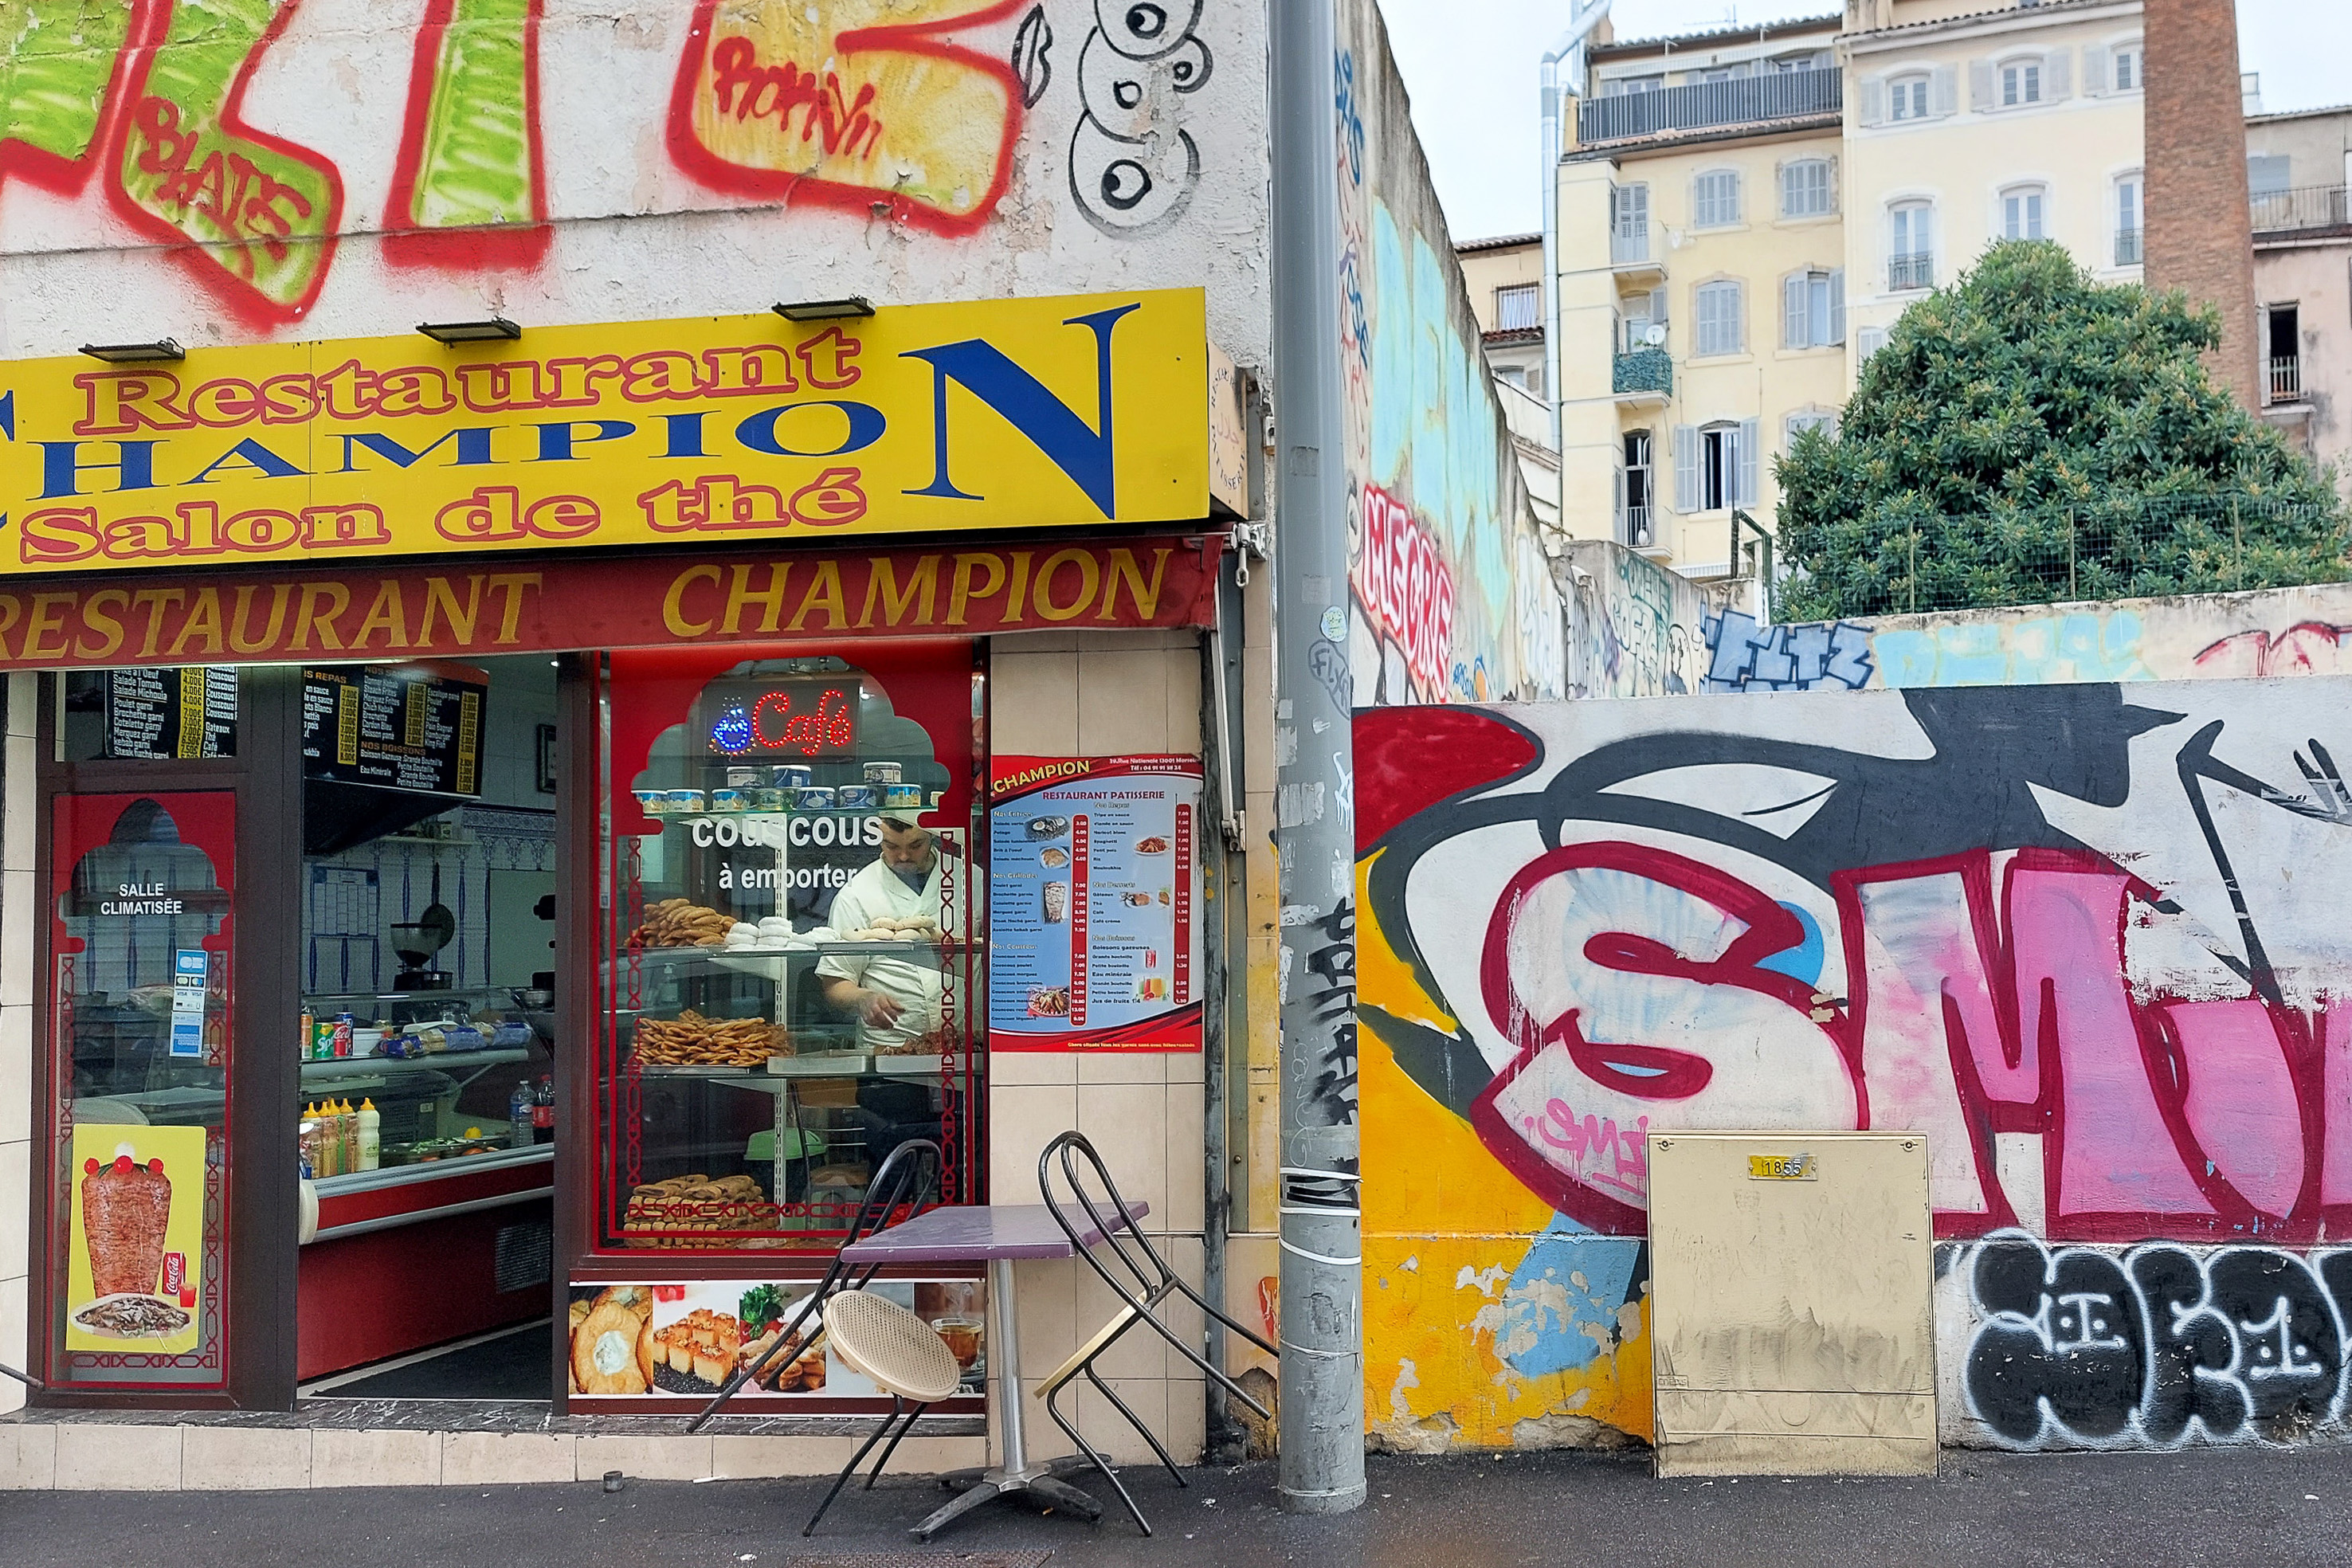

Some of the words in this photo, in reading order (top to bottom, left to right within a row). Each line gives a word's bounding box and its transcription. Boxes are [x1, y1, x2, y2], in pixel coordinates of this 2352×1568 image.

[73, 327, 861, 435] Restaurant
[20, 501, 391, 564] Salon
[434, 485, 602, 542] de
[637, 466, 868, 533] thé
[662, 547, 1174, 637] CHAMPION
[113, 674, 136, 686] Salade
[137, 677, 163, 690] Tomate
[206, 669, 235, 682] Couscous
[316, 672, 347, 684] REPAS
[113, 684, 136, 696] Salade
[206, 679, 235, 692] Couscous
[206, 688, 234, 701] Couscous
[114, 697, 135, 708] Poulet
[136, 702, 153, 711] garni
[206, 698, 234, 711] Couscous
[114, 707, 147, 719] Brochette
[147, 713, 164, 723] garni
[206, 708, 234, 720] Couscous
[114, 717, 144, 729] Cotelette
[144, 723, 162, 732] garni
[752, 689, 852, 755] Café
[114, 726, 141, 739] Merguez
[141, 731, 159, 741] garni
[206, 731, 216, 742] Thé
[114, 736, 133, 747] kebab
[134, 740, 151, 750] garni
[203, 741, 218, 751] Café
[361, 741, 380, 750] NOS
[381, 744, 426, 755] BOISSONS
[993, 759, 1090, 794] CHAMPION
[1042, 791, 1108, 800] RESTAURANT
[1111, 790, 1165, 799] PATISSERIE
[692, 815, 884, 848] couscous
[719, 862, 733, 889] à
[740, 864, 858, 896] emporter
[120, 884, 164, 897] SALLE
[100, 898, 182, 915] CLIMATISÉE
[1765, 1161, 1802, 1175] 1855
